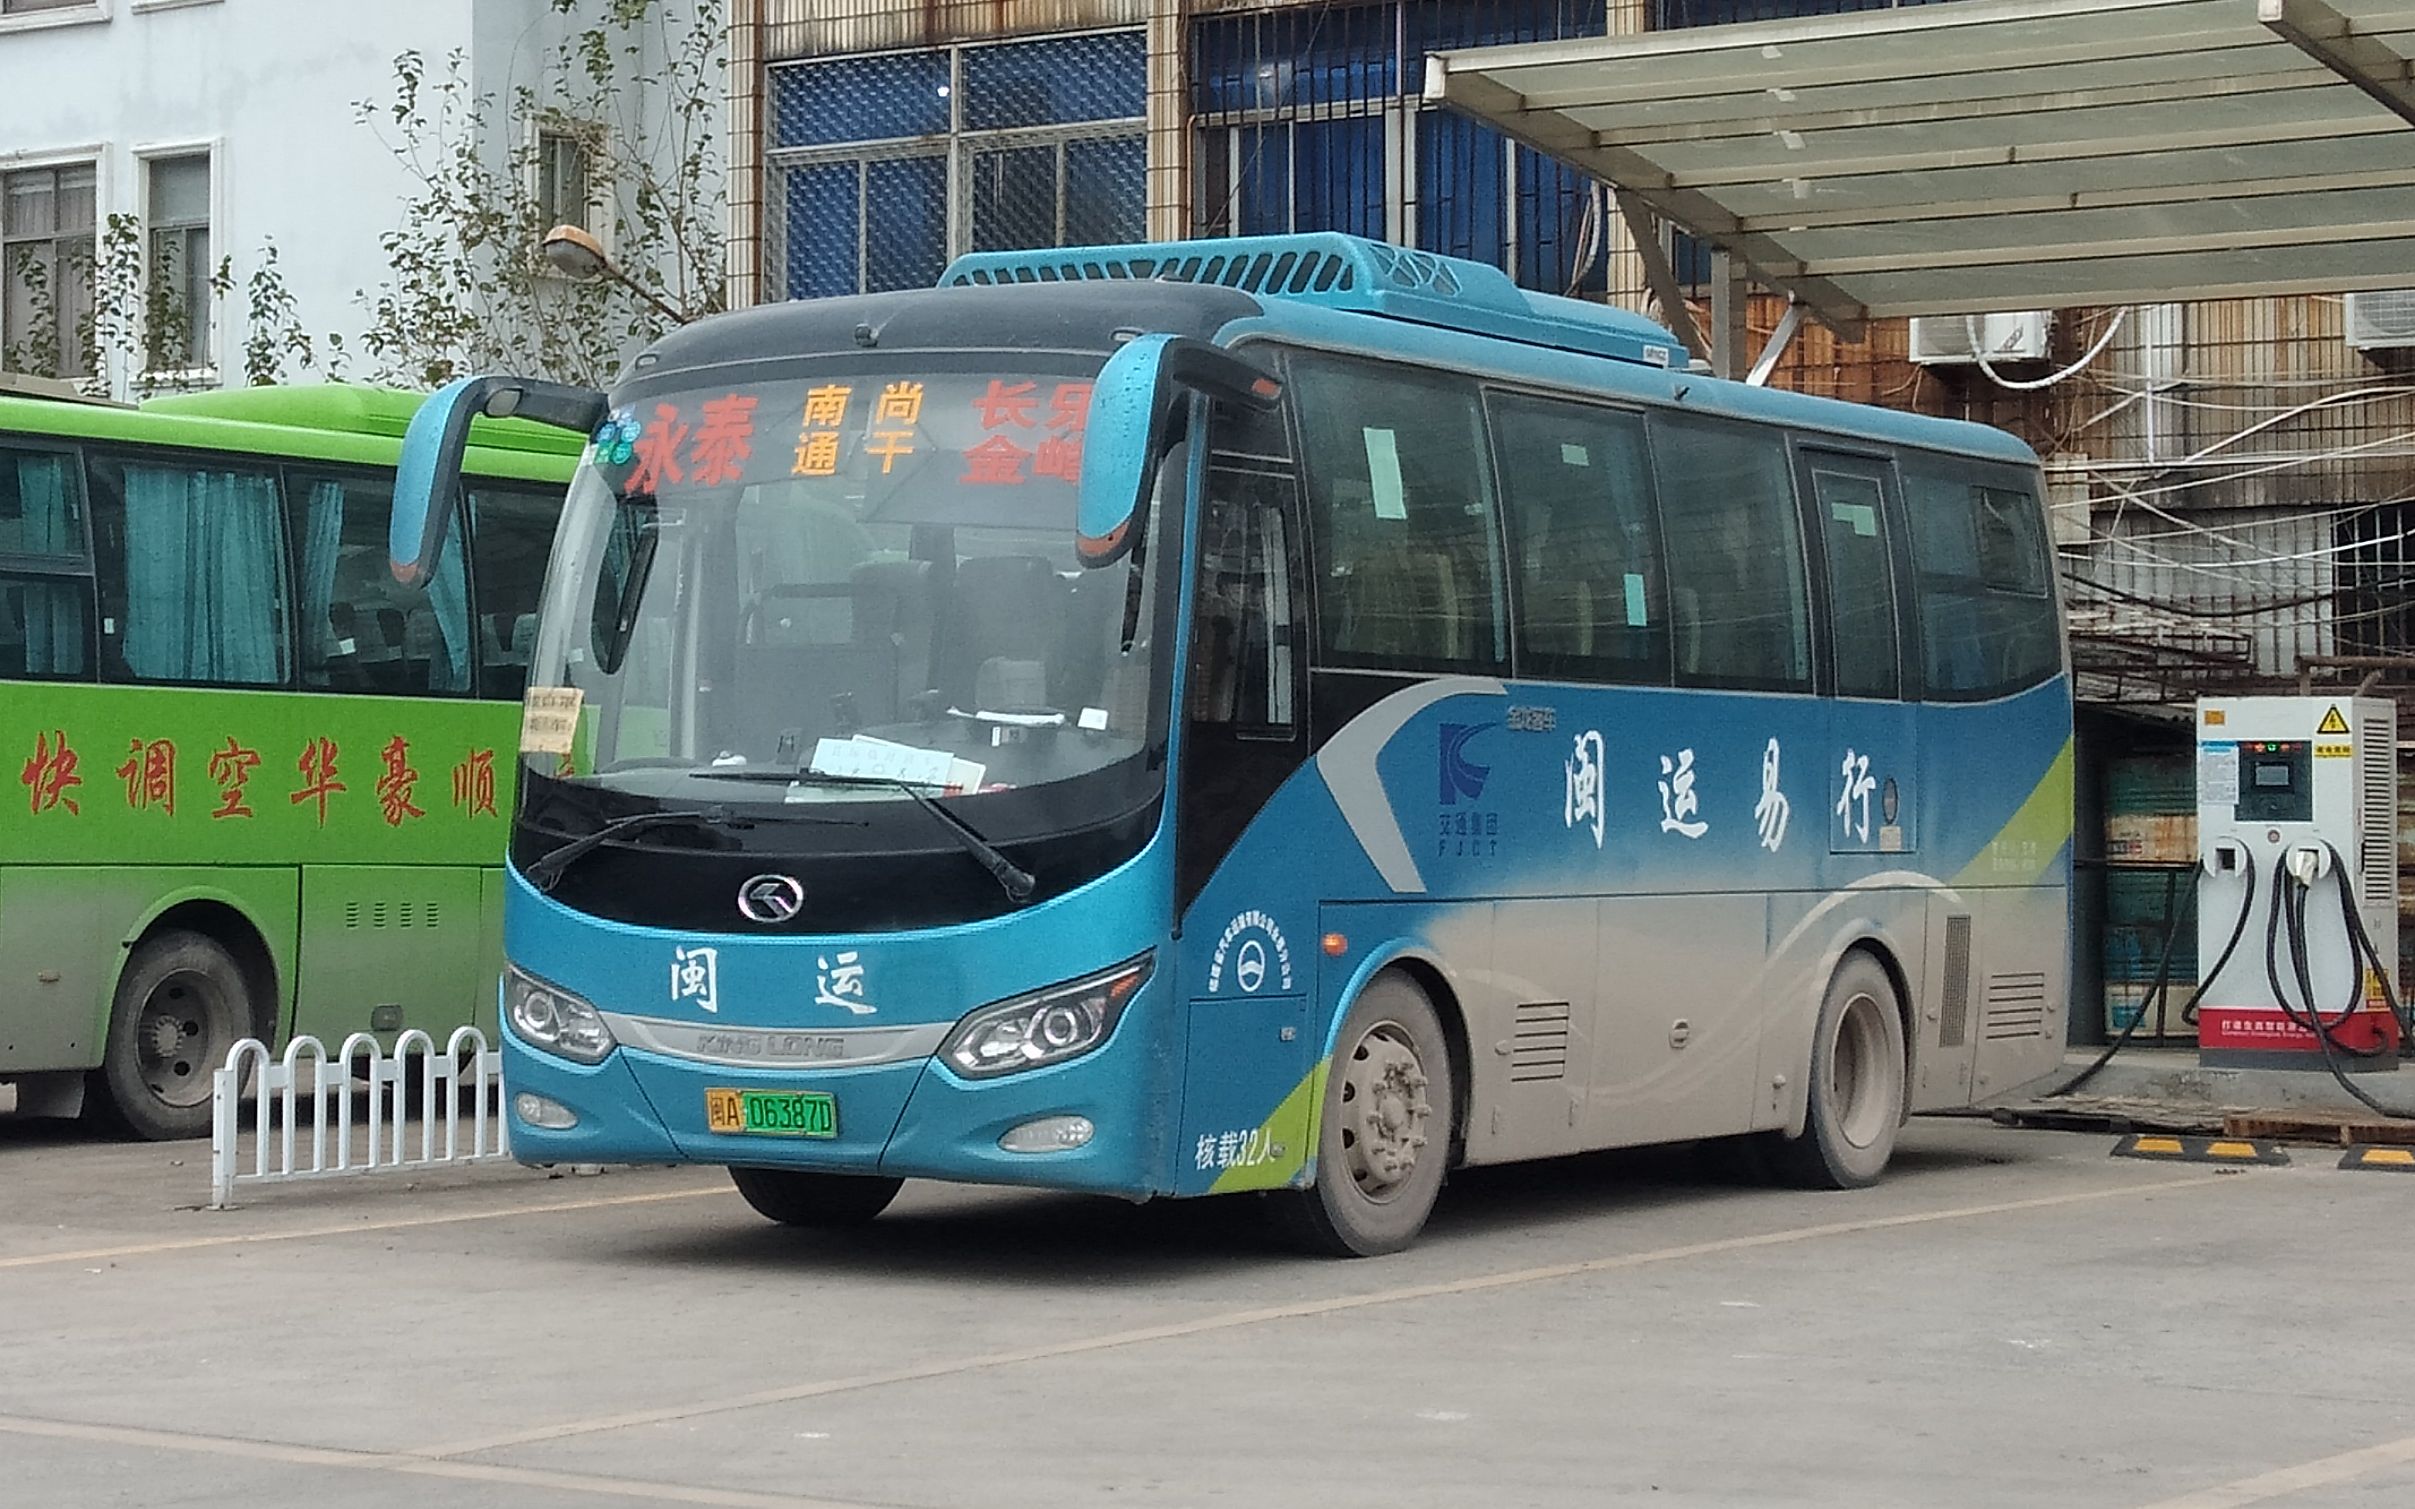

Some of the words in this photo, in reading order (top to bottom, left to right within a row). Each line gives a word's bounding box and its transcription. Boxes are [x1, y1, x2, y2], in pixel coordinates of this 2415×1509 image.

[624, 394, 758, 494] 永泰
[1564, 729, 1877, 853] 闽运易行
[670, 945, 878, 1014] 闽运
[696, 1033, 762, 1056] KING
[767, 1034, 845, 1058] LONG
[1195, 1127, 1276, 1170] 核载32人
